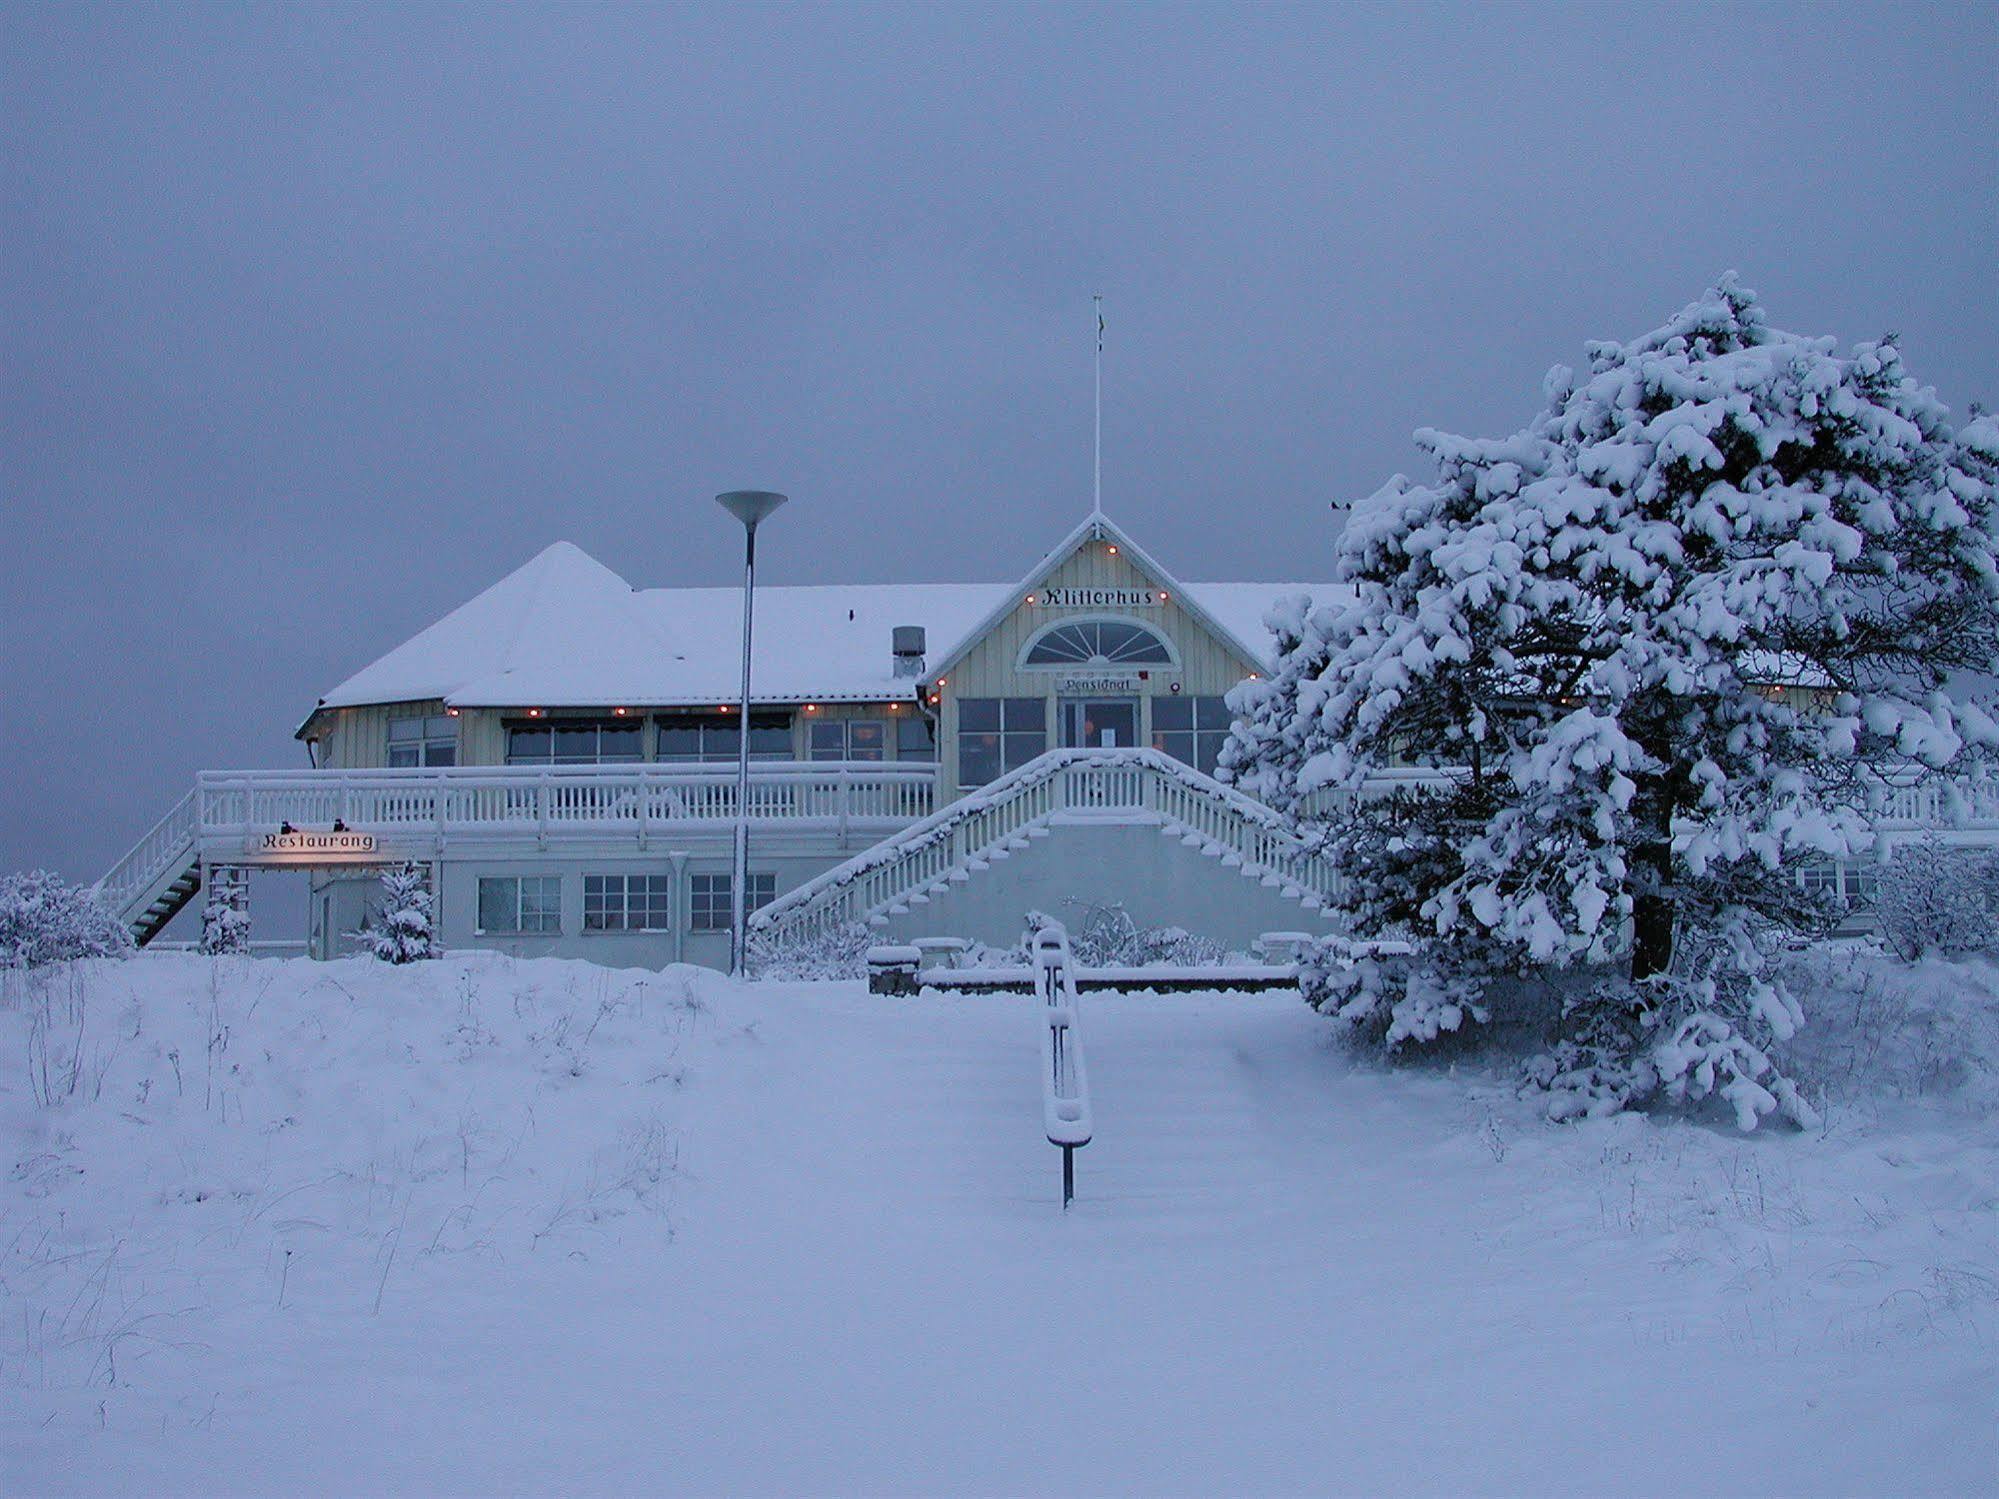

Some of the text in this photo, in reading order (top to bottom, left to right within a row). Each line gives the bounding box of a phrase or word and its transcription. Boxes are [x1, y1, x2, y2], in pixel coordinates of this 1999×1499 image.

[1042, 588, 1152, 605] Klitterhus
[1065, 679, 1130, 692] Pensionat
[262, 834, 373, 850] Restaurang
